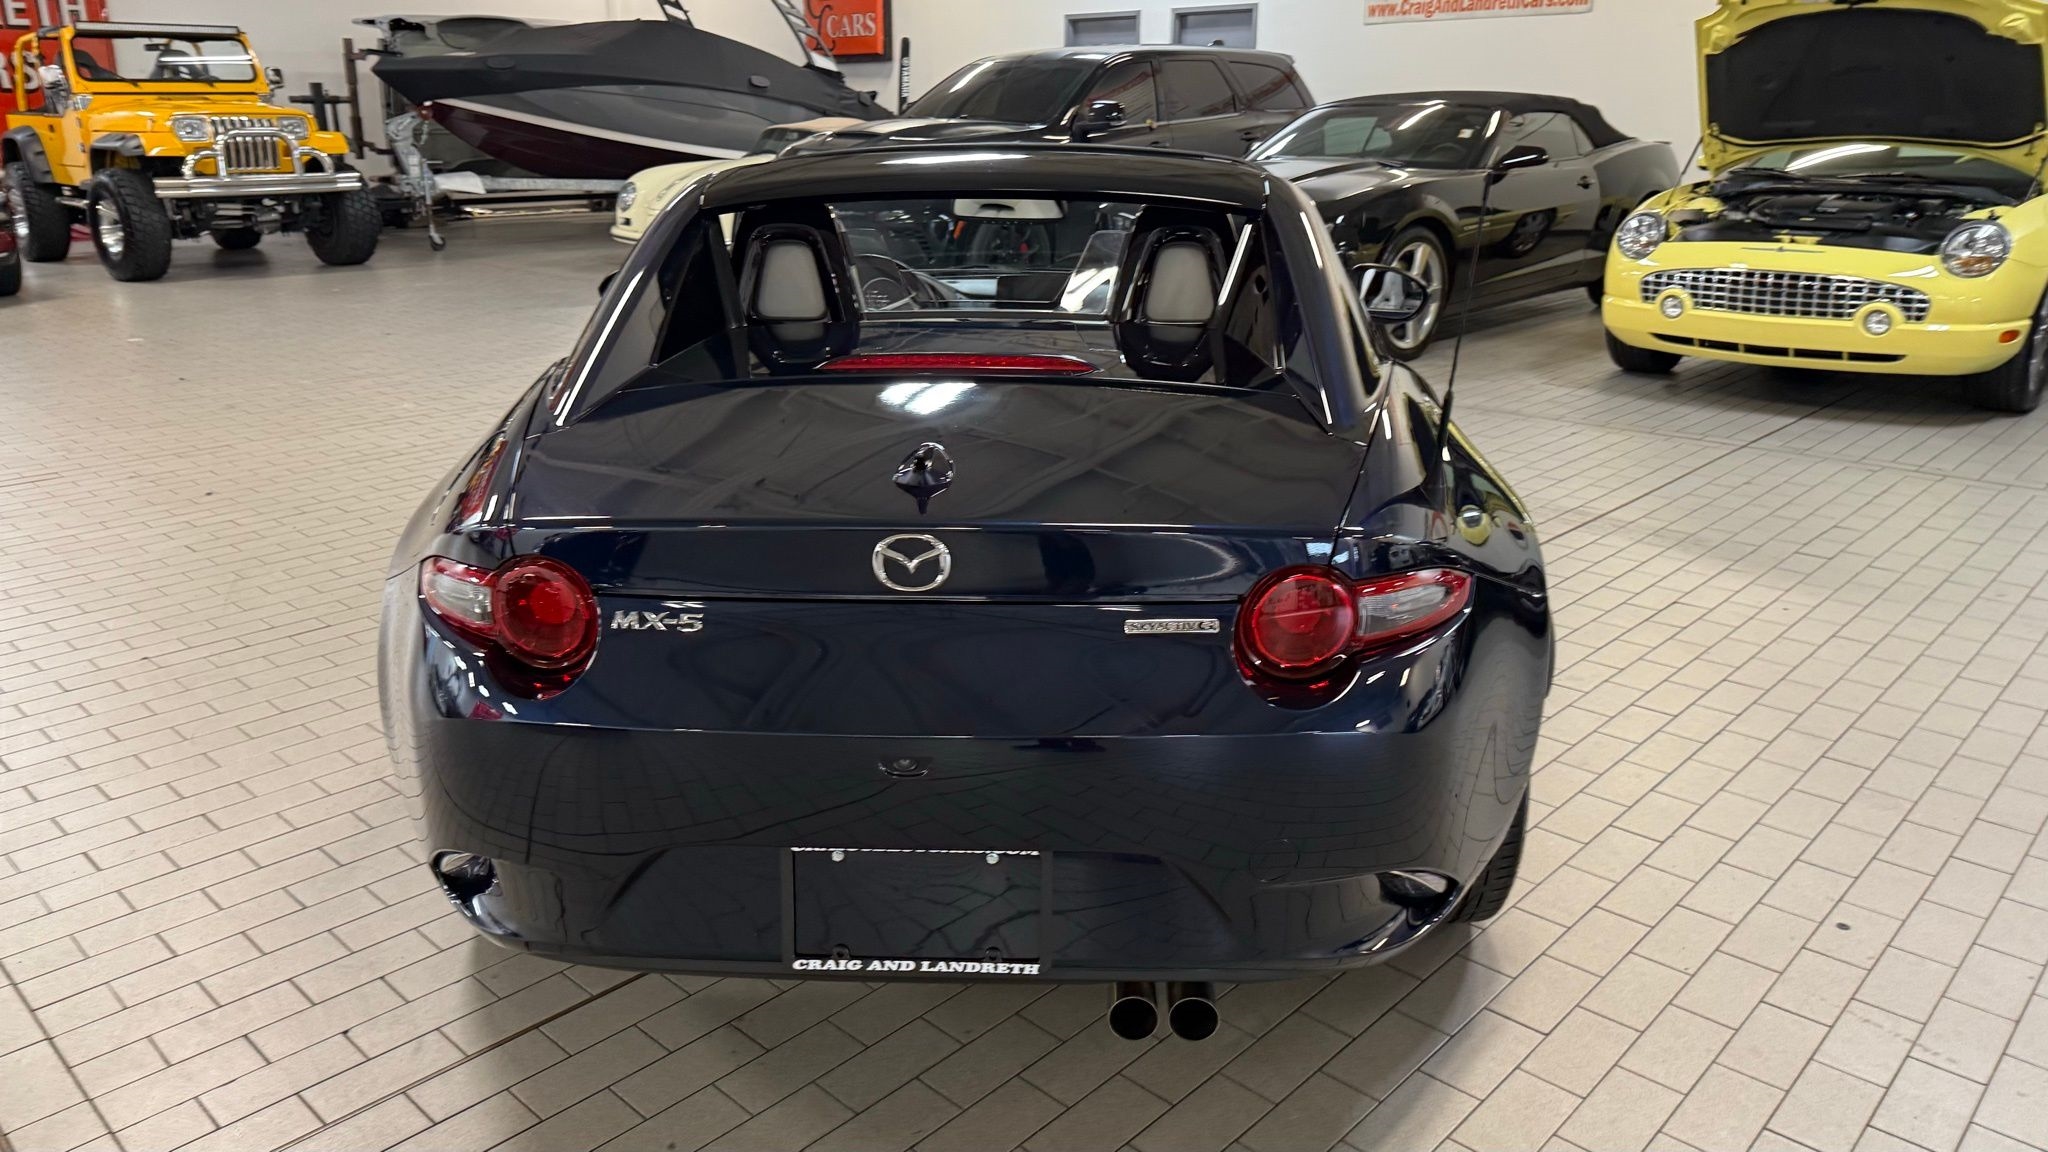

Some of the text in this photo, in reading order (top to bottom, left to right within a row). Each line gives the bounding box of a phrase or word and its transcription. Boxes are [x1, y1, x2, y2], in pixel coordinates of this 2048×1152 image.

[826, 12, 876, 38] CARS
[610, 609, 705, 633] MX-5
[792, 959, 1041, 975] CRAIG AND LANDRETH
